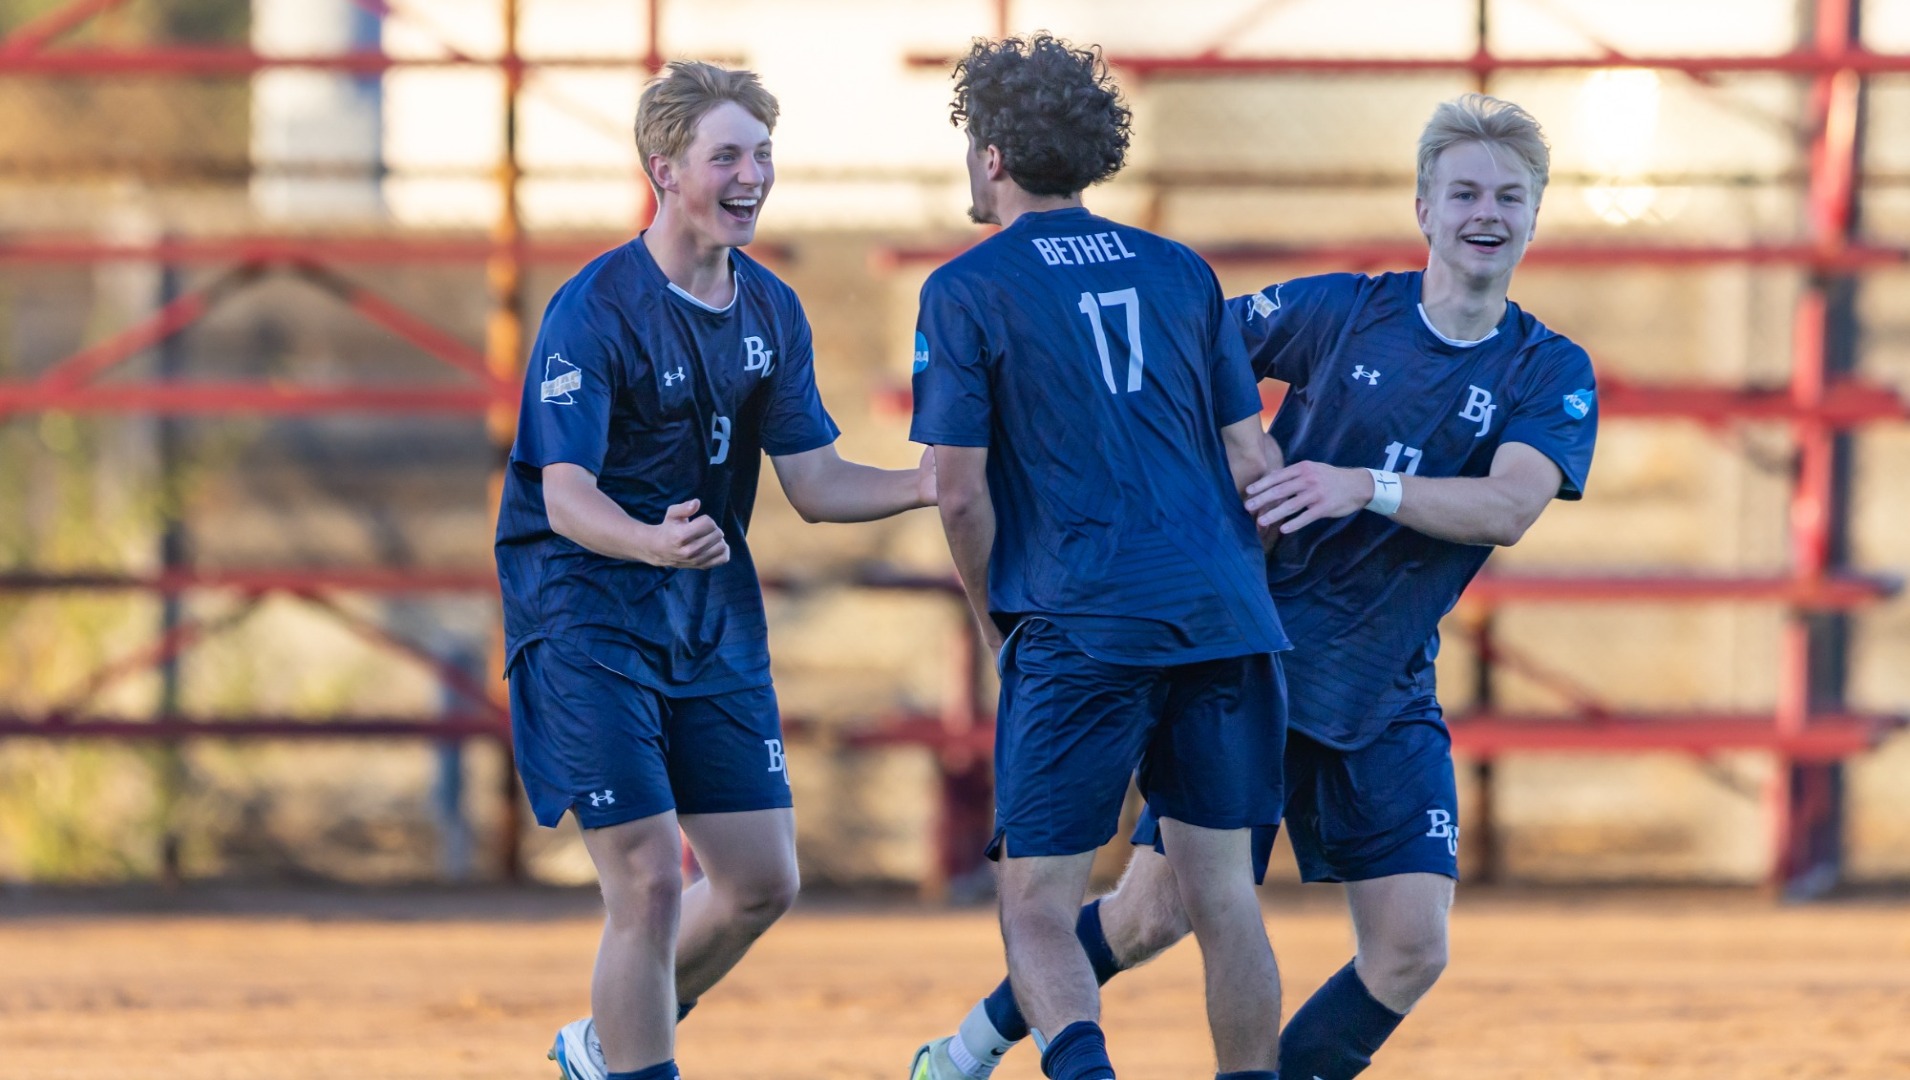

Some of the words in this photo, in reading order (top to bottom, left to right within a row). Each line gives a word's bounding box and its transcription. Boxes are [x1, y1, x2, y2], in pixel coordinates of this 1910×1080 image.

[1032, 231, 1136, 265] BETHEL
[1078, 287, 1143, 394] 17
[1382, 441, 1423, 476] 17
